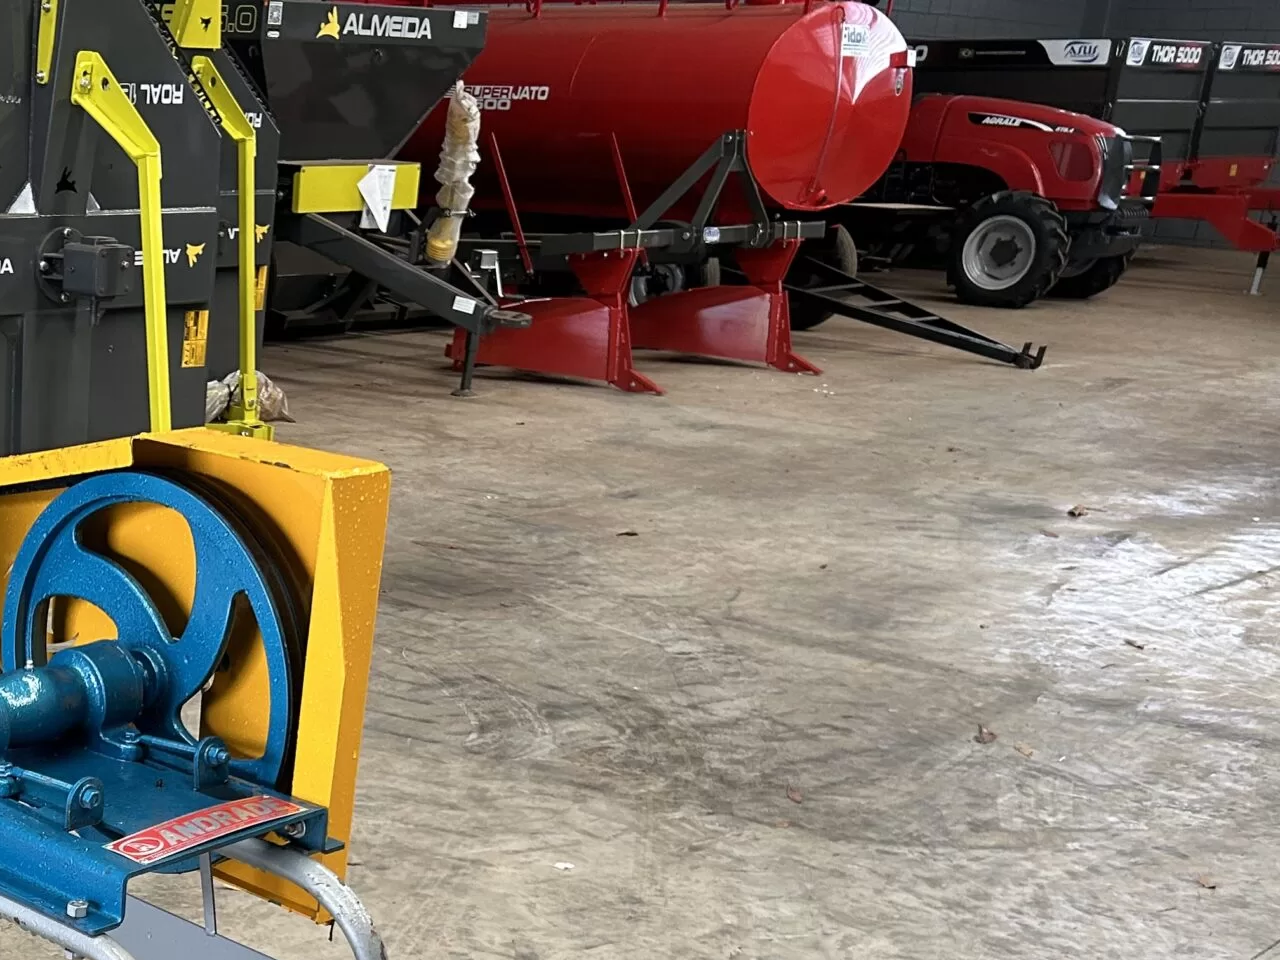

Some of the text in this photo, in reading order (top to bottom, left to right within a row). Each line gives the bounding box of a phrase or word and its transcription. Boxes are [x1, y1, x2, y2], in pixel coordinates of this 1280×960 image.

[342, 12, 432, 40] ALMEIDA
[1151, 45, 1176, 63] THOR
[1176, 46, 1202, 64] 5000
[1242, 49, 1266, 65] THOR
[140, 83, 184, 105] ROAL
[463, 86, 550, 100] SUPER JATO
[981, 116, 1021, 127] AGRALE
[159, 799, 283, 846] ANDRADE
